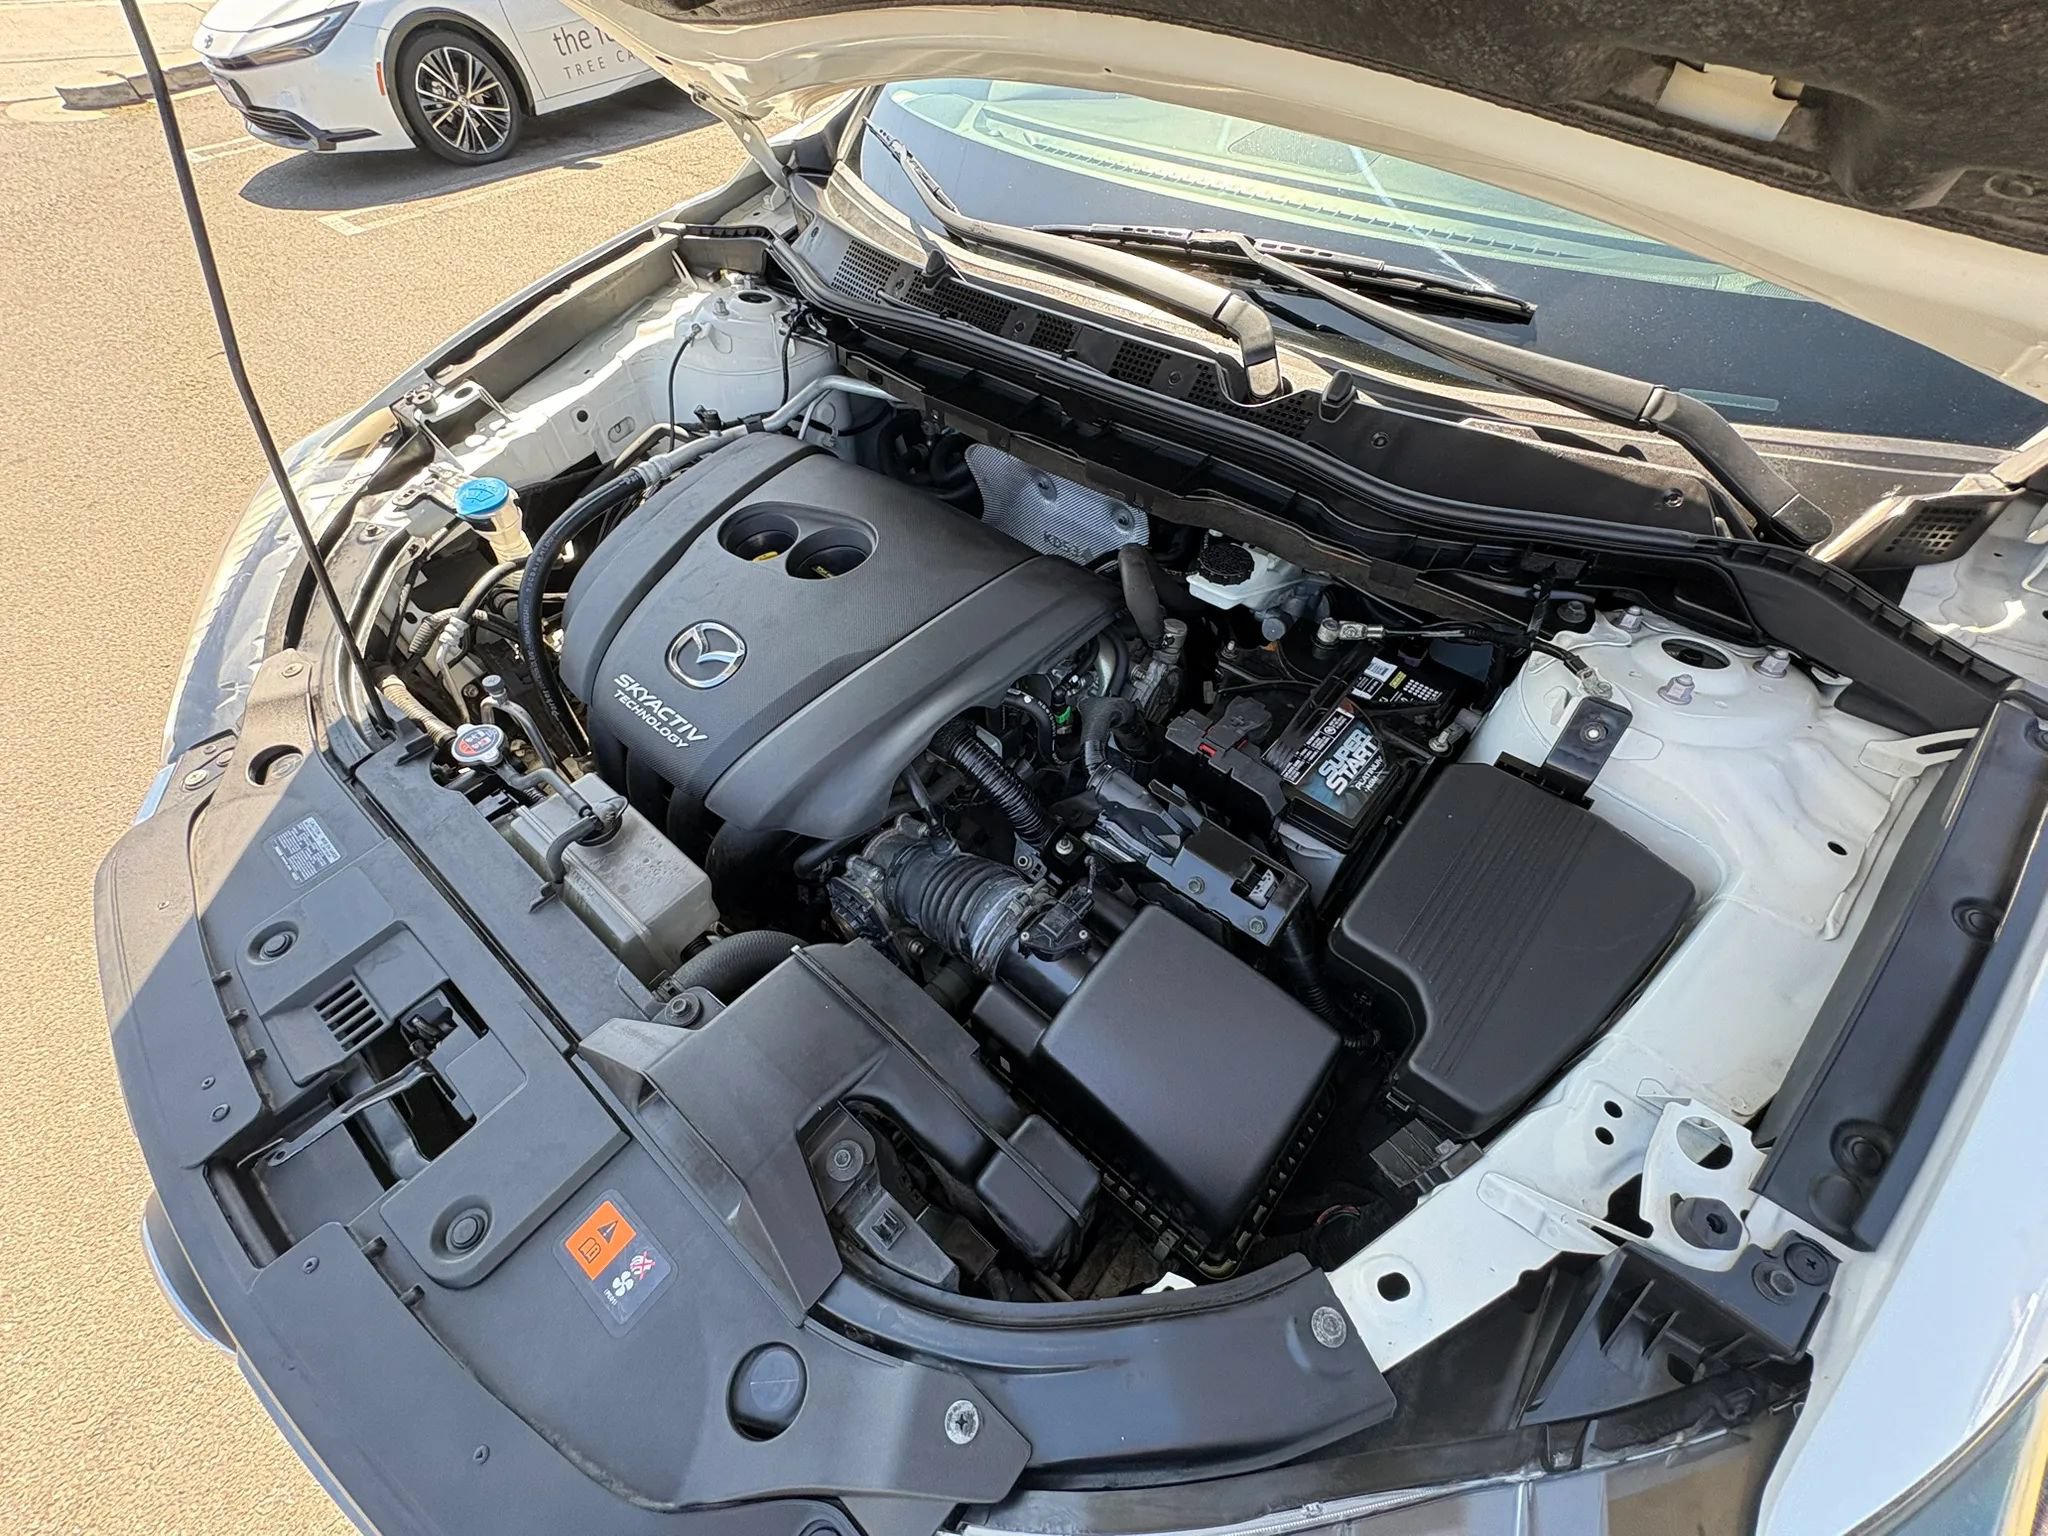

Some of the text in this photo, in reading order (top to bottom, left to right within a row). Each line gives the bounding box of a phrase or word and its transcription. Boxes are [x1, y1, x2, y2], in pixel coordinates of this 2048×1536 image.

[553, 27, 592, 56] the
[563, 57, 605, 79] TREE
[613, 673, 709, 742] SKYACTIV
[613, 689, 689, 748] TECHNOLOGY
[1318, 729, 1368, 776] SUPER
[1326, 734, 1378, 795] START
